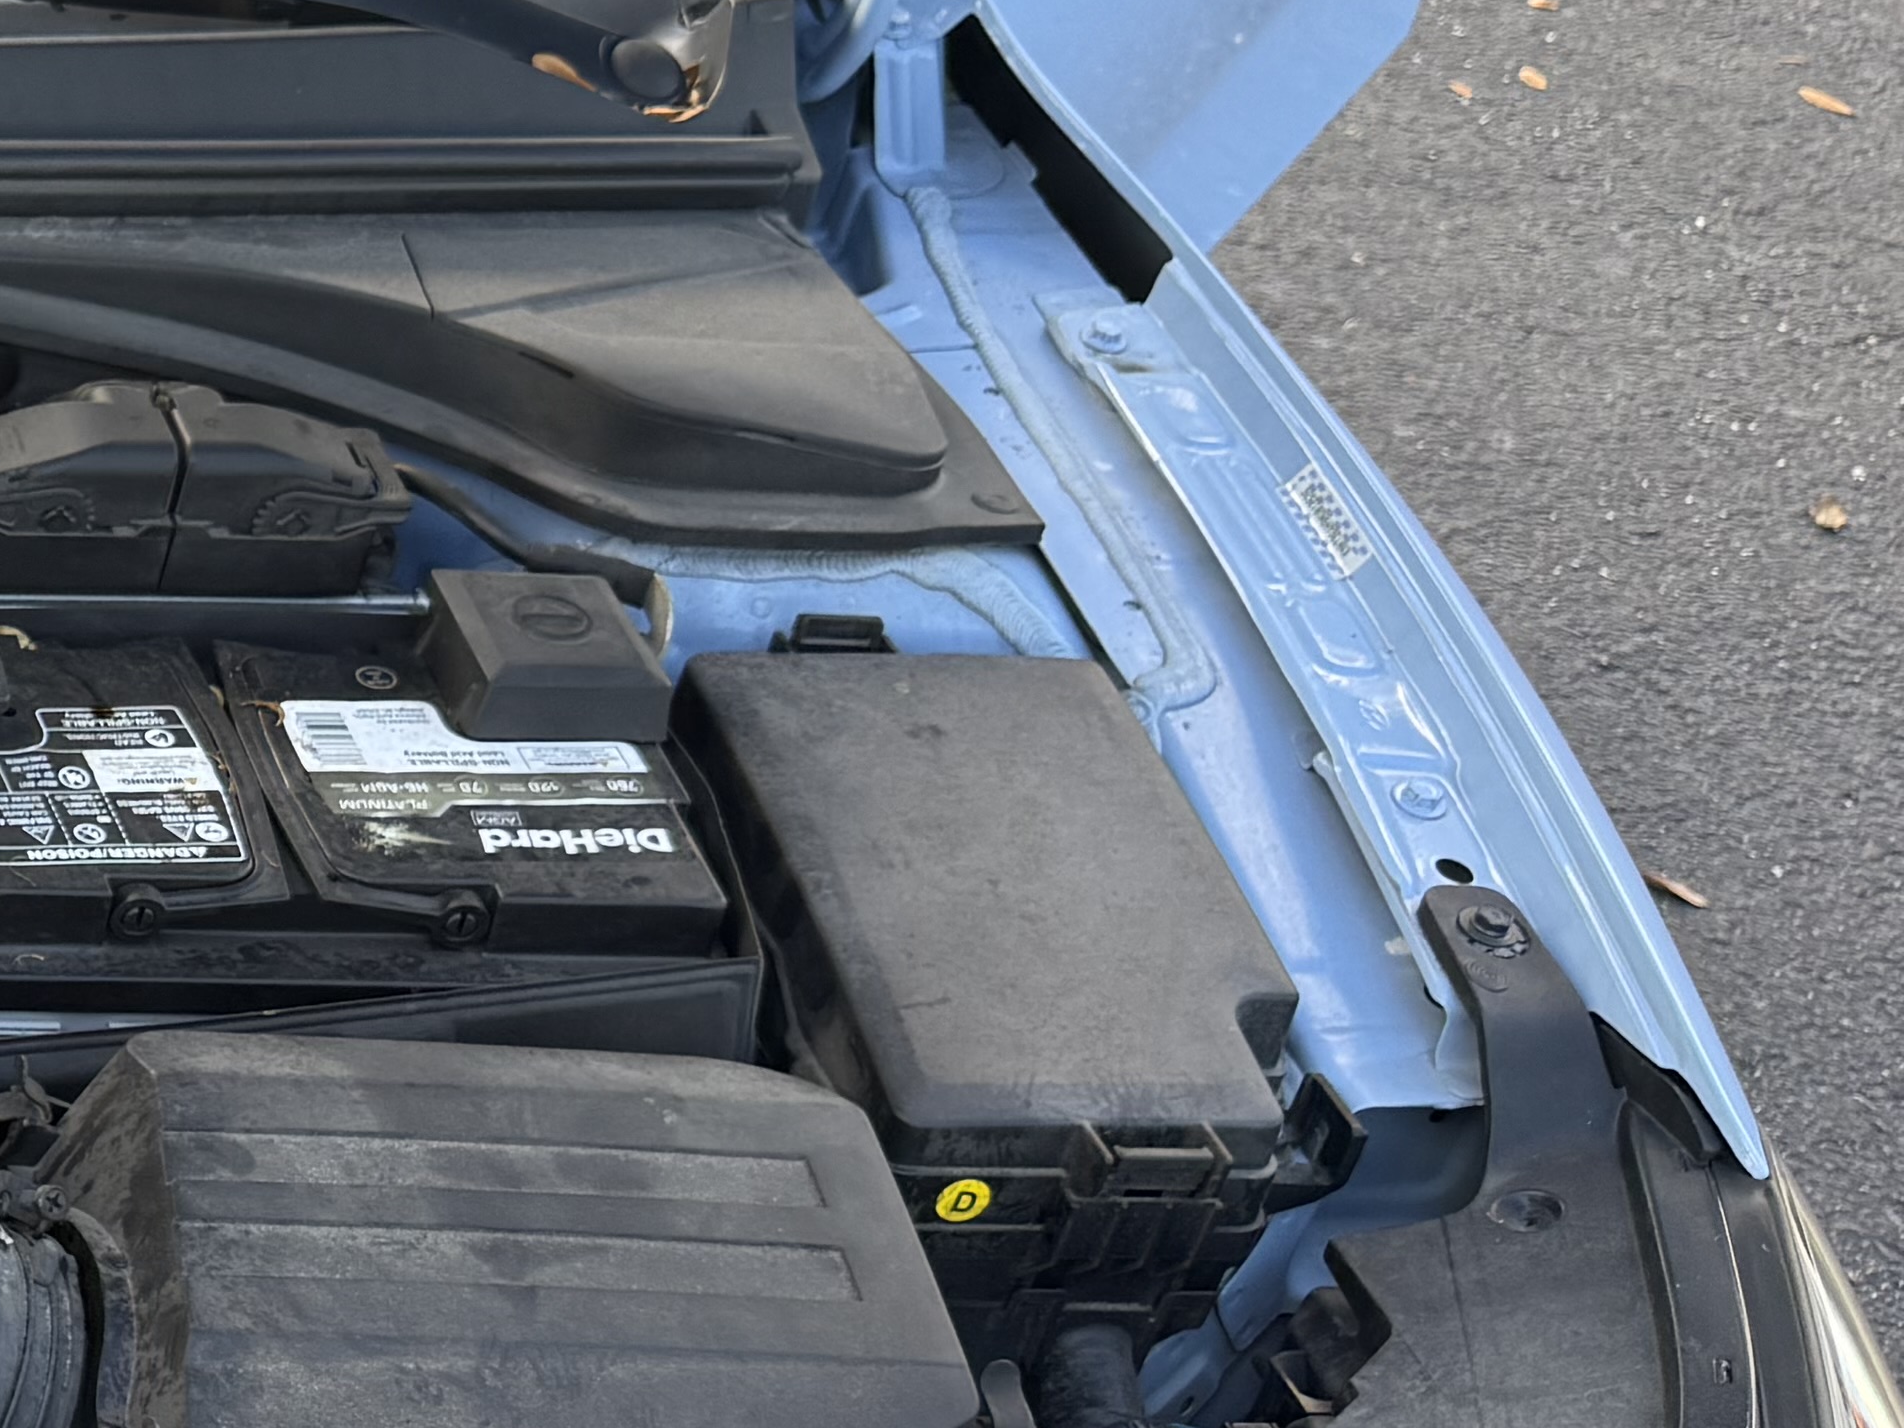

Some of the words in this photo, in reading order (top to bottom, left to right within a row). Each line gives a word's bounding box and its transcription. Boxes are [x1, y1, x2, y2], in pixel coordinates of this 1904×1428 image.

[338, 798, 429, 810] PLATINUM
[477, 827, 674, 855] DieHard
[950, 1188, 978, 1214] D
